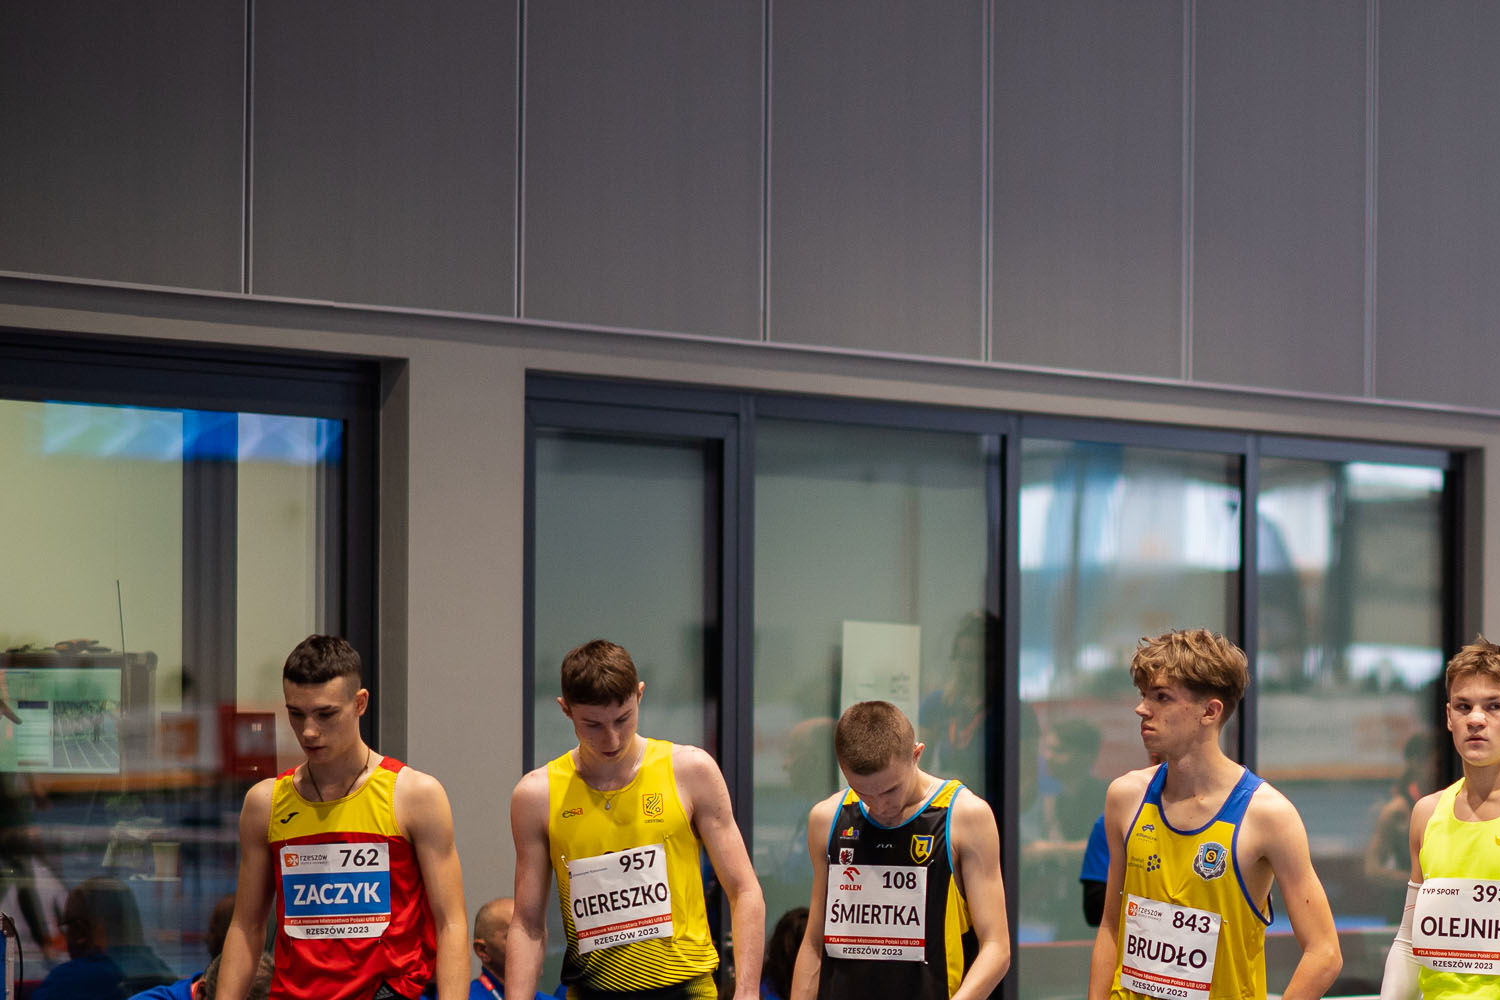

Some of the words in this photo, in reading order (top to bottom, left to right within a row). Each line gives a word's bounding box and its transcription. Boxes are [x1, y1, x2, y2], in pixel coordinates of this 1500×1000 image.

[339, 848, 379, 867] 762
[619, 850, 656, 873] 957
[882, 871, 917, 890] 108
[293, 882, 381, 906] ZACZYK
[573, 882, 668, 919] CIERESZKO
[1437, 888, 1460, 896] SPORT
[830, 899, 920, 926] ŚMIERTKA
[1172, 911, 1211, 933] 843
[306, 925, 346, 936] RZESZÓW
[347, 926, 369, 935] 2023
[594, 930, 635, 946] RZESZÓW
[638, 926, 659, 938] 2023
[842, 946, 880, 956] RZESZÓW
[881, 948, 903, 956] 2023
[1127, 934, 1207, 969] BRUDŁO
[1432, 958, 1473, 969] RZESZÓW
[1474, 961, 1493, 970] 2023
[1132, 979, 1165, 994] RZESZÓW
[1166, 987, 1188, 998] 2023
